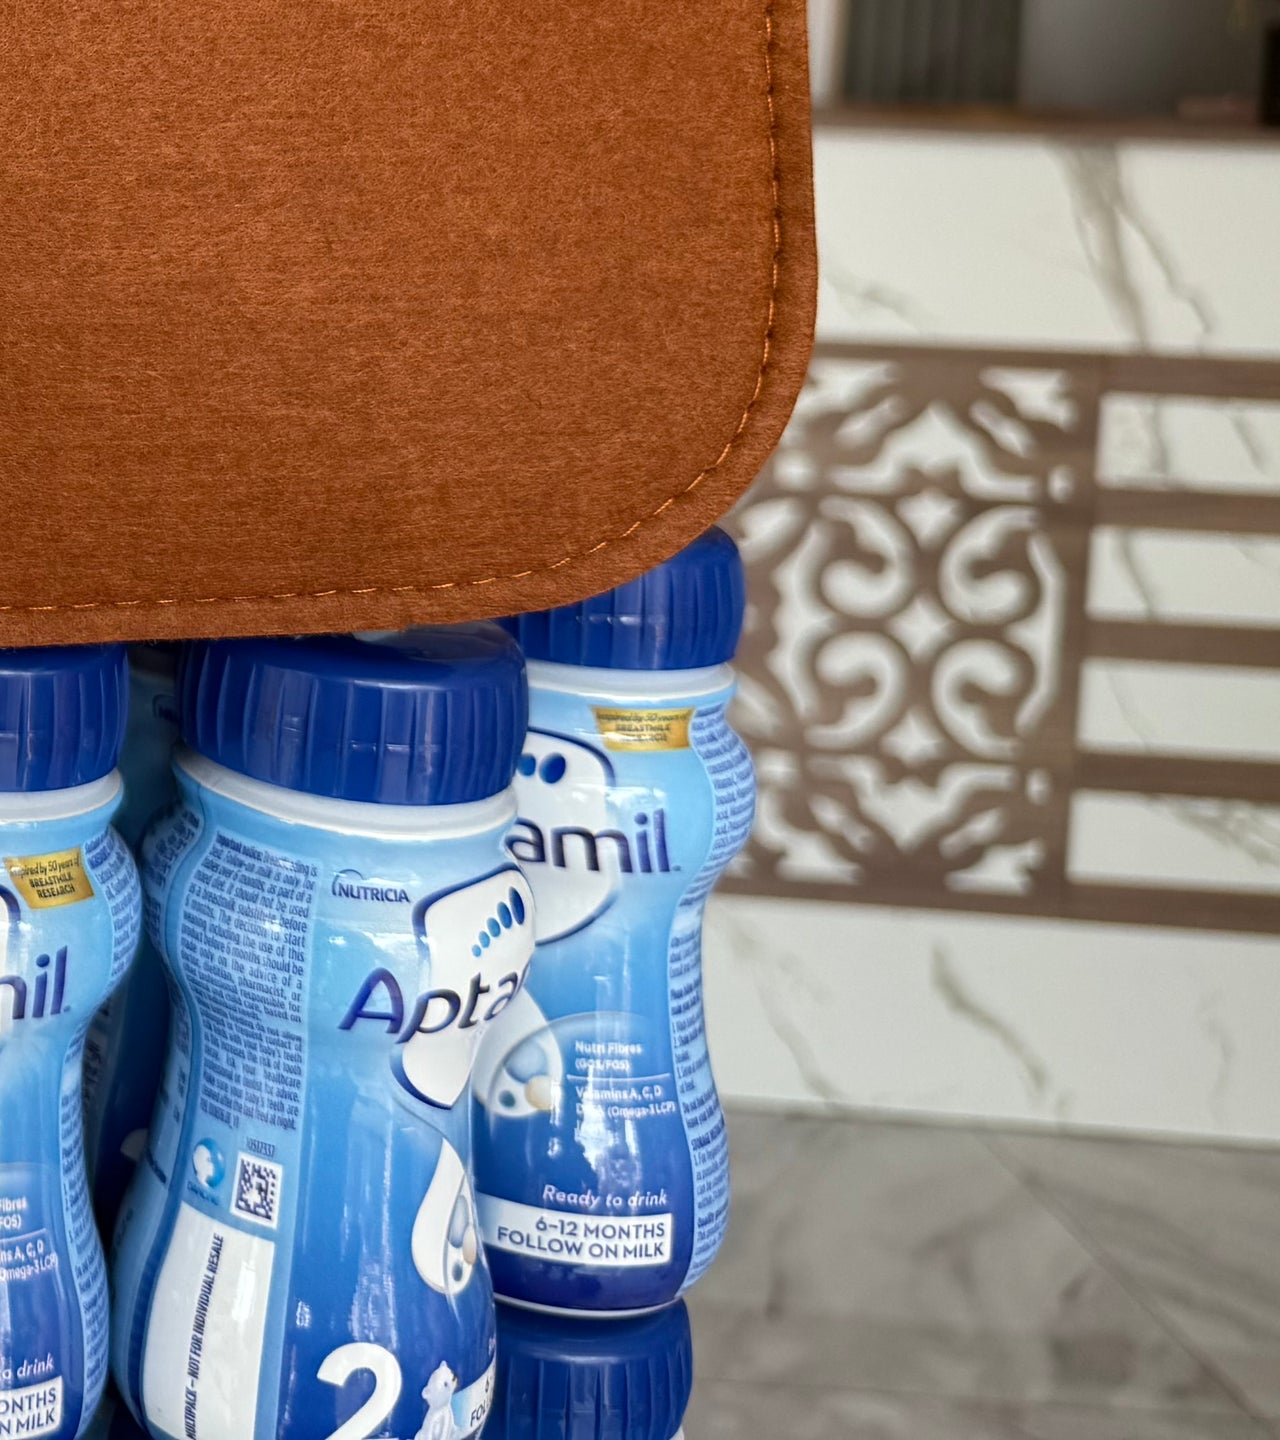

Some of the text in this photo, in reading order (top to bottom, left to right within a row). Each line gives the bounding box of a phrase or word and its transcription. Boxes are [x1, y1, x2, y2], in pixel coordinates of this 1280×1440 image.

[48, 859, 58, 873] 50
[28, 871, 74, 889] BREASTMILK
[35, 883, 76, 899] RESEARCH
[338, 883, 411, 904] NUTRICIA
[543, 1183, 668, 1210] Ready to drink
[583, 1220, 666, 1240] MONTHS
[206, 1233, 224, 1275] RESALE
[496, 1226, 665, 1260] FOLLOW ON MILK
[192, 1272, 216, 1334] INDIVIDUAL
[190, 1333, 203, 1358] FOR
[16, 1352, 55, 1380] drink
[187, 1356, 200, 1380] NOT
[316, 1341, 402, 1440] 2
[14, 1410, 56, 1435] MILK
